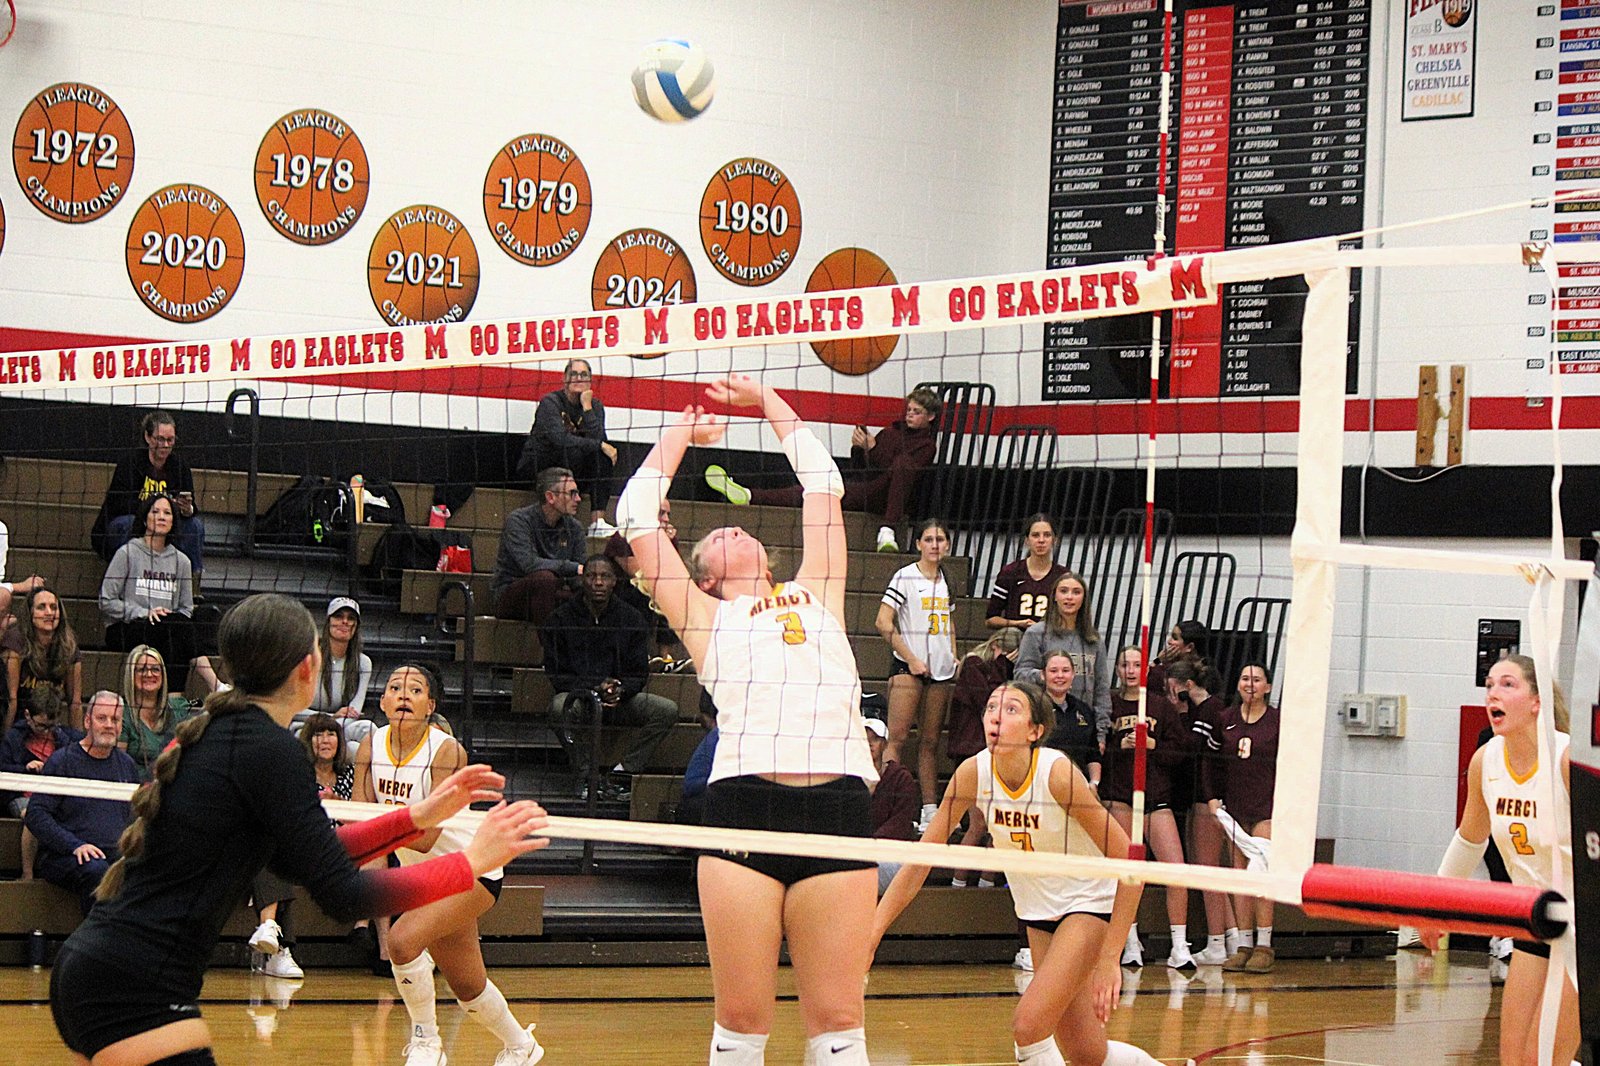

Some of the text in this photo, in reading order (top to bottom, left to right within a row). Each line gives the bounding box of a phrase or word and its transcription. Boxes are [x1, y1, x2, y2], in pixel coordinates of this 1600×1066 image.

[1412, 41, 1468, 58] ST. MARY'S
[1416, 59, 1462, 73] CHELSEA
[1407, 75, 1470, 92] GREENVILLE
[44, 87, 110, 114] LEAGUE
[1412, 92, 1464, 108] CADILLAC
[284, 114, 347, 138] LEAGUE
[31, 128, 118, 169] 1972
[511, 139, 570, 163] LEAGUE
[271, 153, 354, 192] 1978
[725, 161, 781, 185] LEAGUE
[26, 176, 122, 216] CHAMPIONS
[156, 189, 222, 215] LEAGUE
[499, 177, 578, 214] 1979
[267, 200, 356, 239] CHAMPIONS
[395, 210, 457, 234] LEAGUE
[714, 199, 788, 236] 1980
[141, 230, 227, 270] 2020
[496, 221, 580, 260] CHAMPIONS
[617, 234, 676, 256] LEAGUE
[386, 250, 463, 288] 2021
[710, 243, 790, 280] CHAMPIONS
[141, 280, 227, 317] CHAMPIONS
[607, 274, 684, 308] 2024
[891, 258, 1206, 327] M GO EAGLETS M
[382, 299, 463, 326] CHAONS
[470, 295, 864, 356] GO EAGLETS M GO EAGLETS
[59, 350, 77, 381] M
[93, 351, 116, 378] GO
[124, 344, 210, 377] EAGLETS
[231, 338, 251, 371] M
[271, 339, 295, 369] GO
[304, 332, 404, 366] EAGLETS
[425, 325, 447, 360] M
[750, 590, 811, 616] MERCY
[921, 597, 949, 610] MERC
[1020, 594, 1048, 616] 22
[775, 612, 806, 645] 3
[928, 613, 948, 636] 37
[379, 778, 413, 798] MERCY
[995, 808, 1039, 830] MERCY
[1509, 822, 1535, 855] 2
